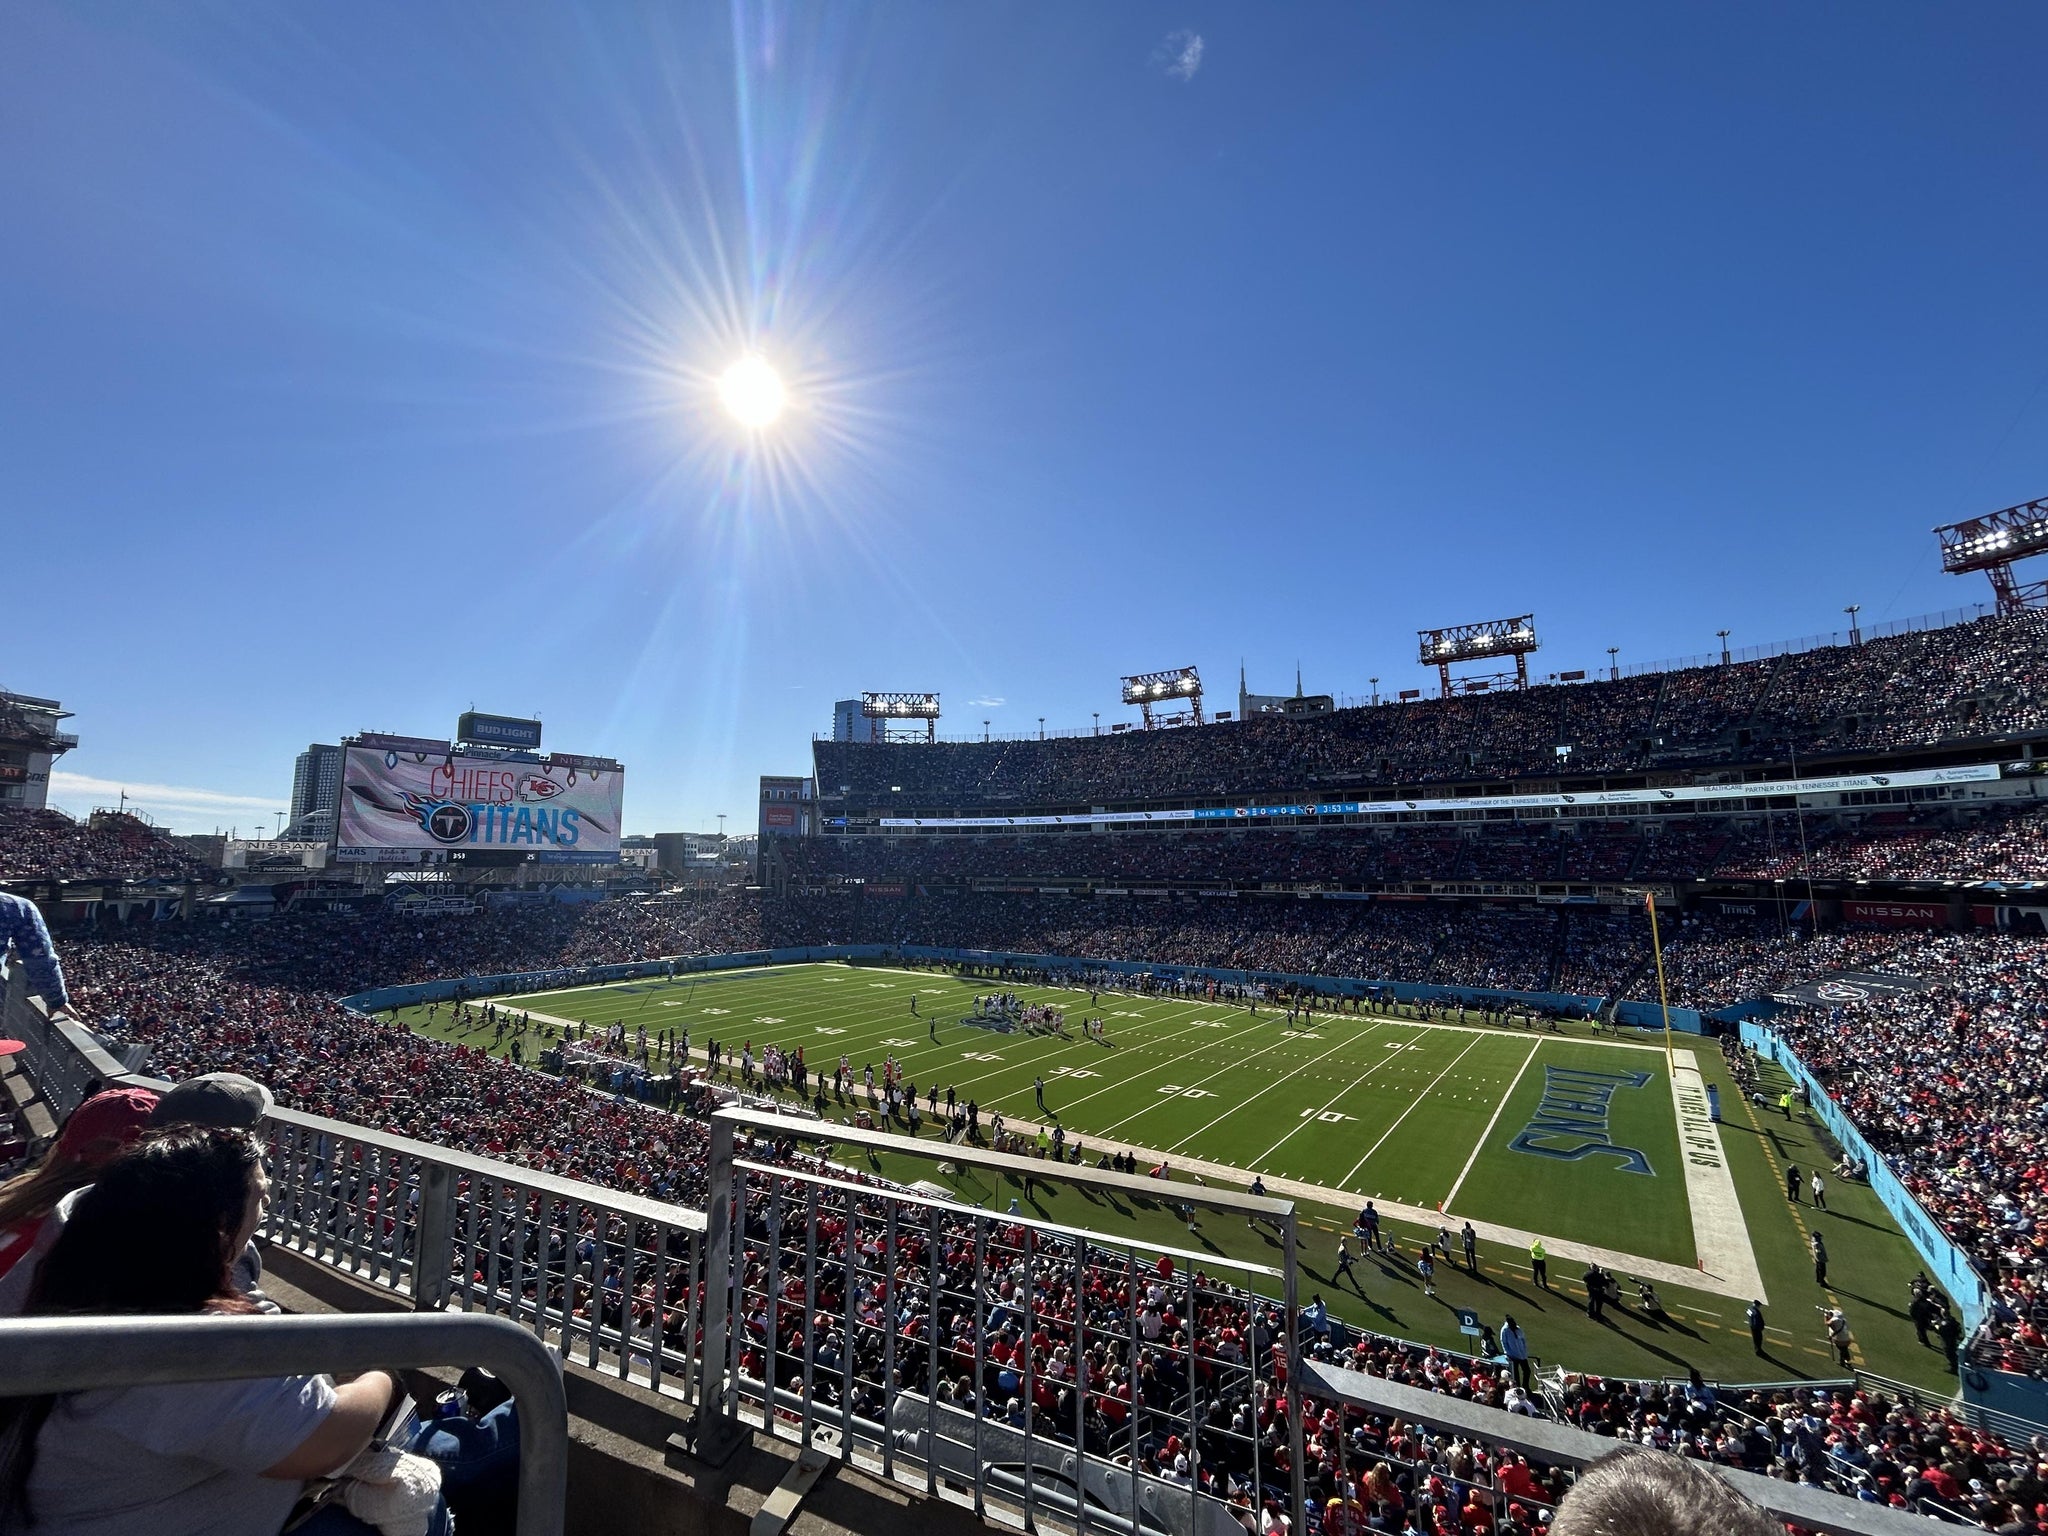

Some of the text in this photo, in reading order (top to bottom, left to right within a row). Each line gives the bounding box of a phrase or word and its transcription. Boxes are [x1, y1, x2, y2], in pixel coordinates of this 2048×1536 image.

[476, 724, 534, 738] BUD LIGHT
[465, 750, 501, 759] Pinnacle
[560, 756, 608, 768] NISSAN
[431, 766, 514, 801] CHIEFS
[1801, 781, 1840, 790] TENNESSEE
[1323, 805, 1342, 813] 3:53
[470, 804, 579, 845] TITANS
[248, 842, 316, 850] NISSAN
[1720, 904, 1756, 915] TITANS
[1856, 906, 1934, 918] NISSAN
[1774, 997, 1807, 1008] NISSAN
[879, 1038, 918, 1048] 50
[960, 1052, 1000, 1062] 40
[1049, 1066, 1094, 1078] 30
[1156, 1084, 1208, 1098] 20
[1678, 1094, 1707, 1116] TAKES
[1300, 1108, 1346, 1122] 10
[1507, 1064, 1657, 1177] TITANS
[1681, 1116, 1712, 1133] ALL
[1686, 1136, 1716, 1150] OF
[1688, 1152, 1721, 1168] US
[1464, 1316, 1473, 1325] D
[1276, 1356, 1287, 1368] 15
